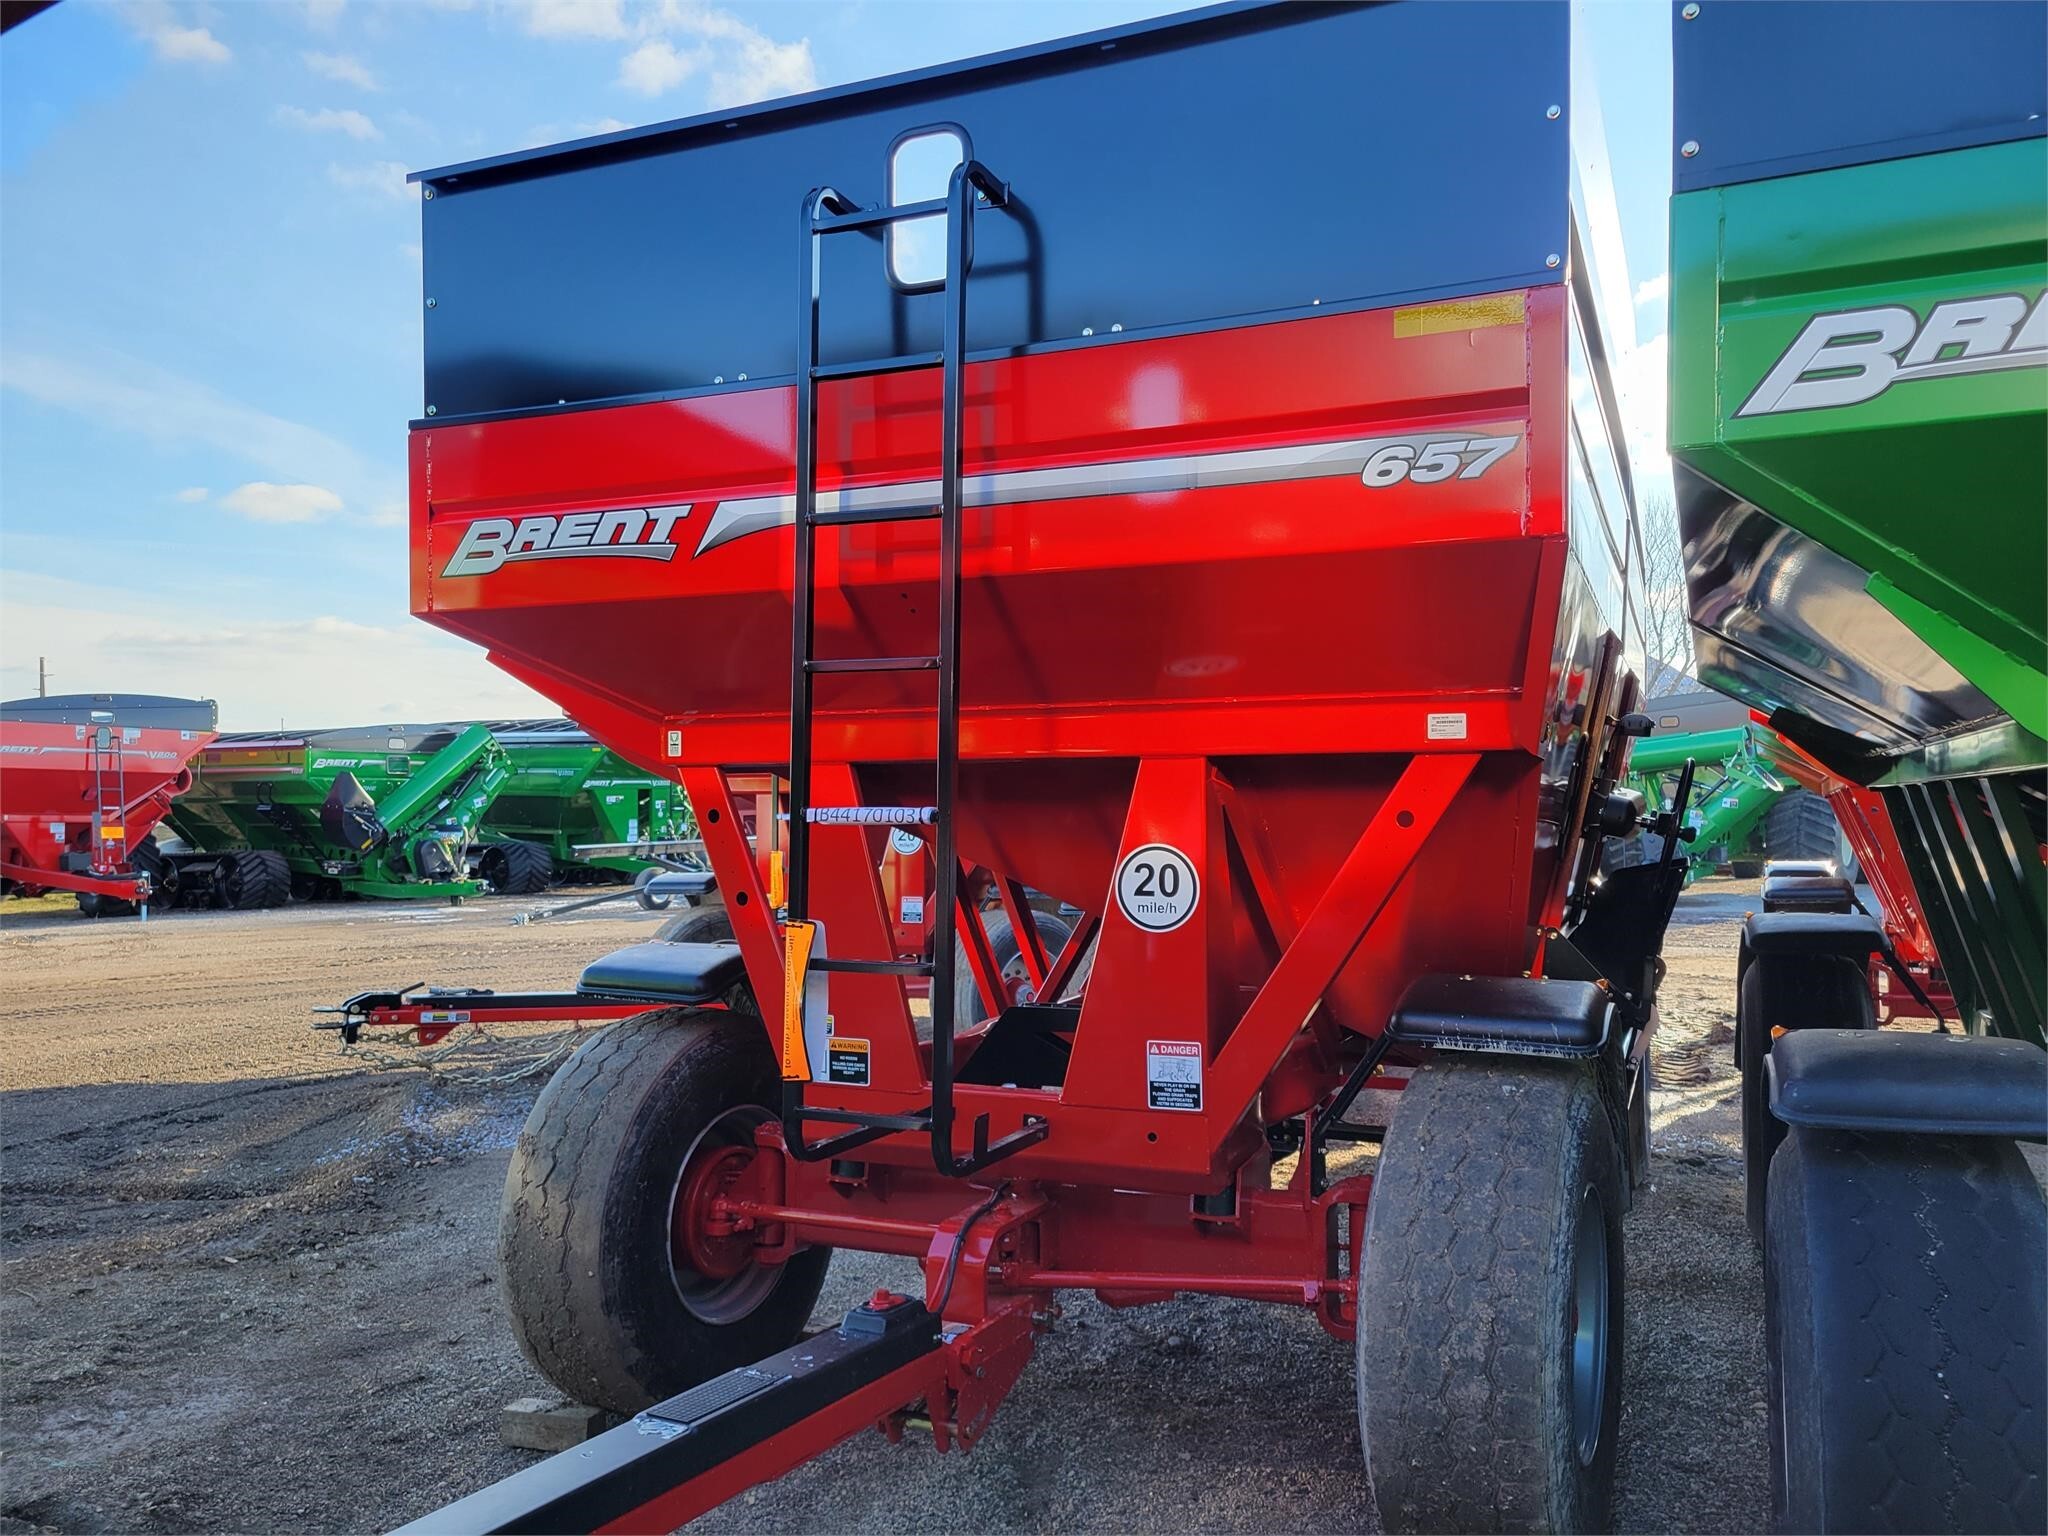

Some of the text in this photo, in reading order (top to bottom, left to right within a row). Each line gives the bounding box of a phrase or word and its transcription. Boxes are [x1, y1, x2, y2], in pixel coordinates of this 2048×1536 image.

[1361, 434, 1522, 488] 657
[440, 503, 693, 577] BRENT
[312, 758, 358, 768] BRENT
[820, 808, 915, 823] B44170103
[1134, 863, 1179, 897] 20
[1138, 902, 1177, 914] mile/h
[837, 1042, 867, 1050] WARNING
[1161, 1046, 1198, 1055] DANGER
[785, 1059, 791, 1068] to
